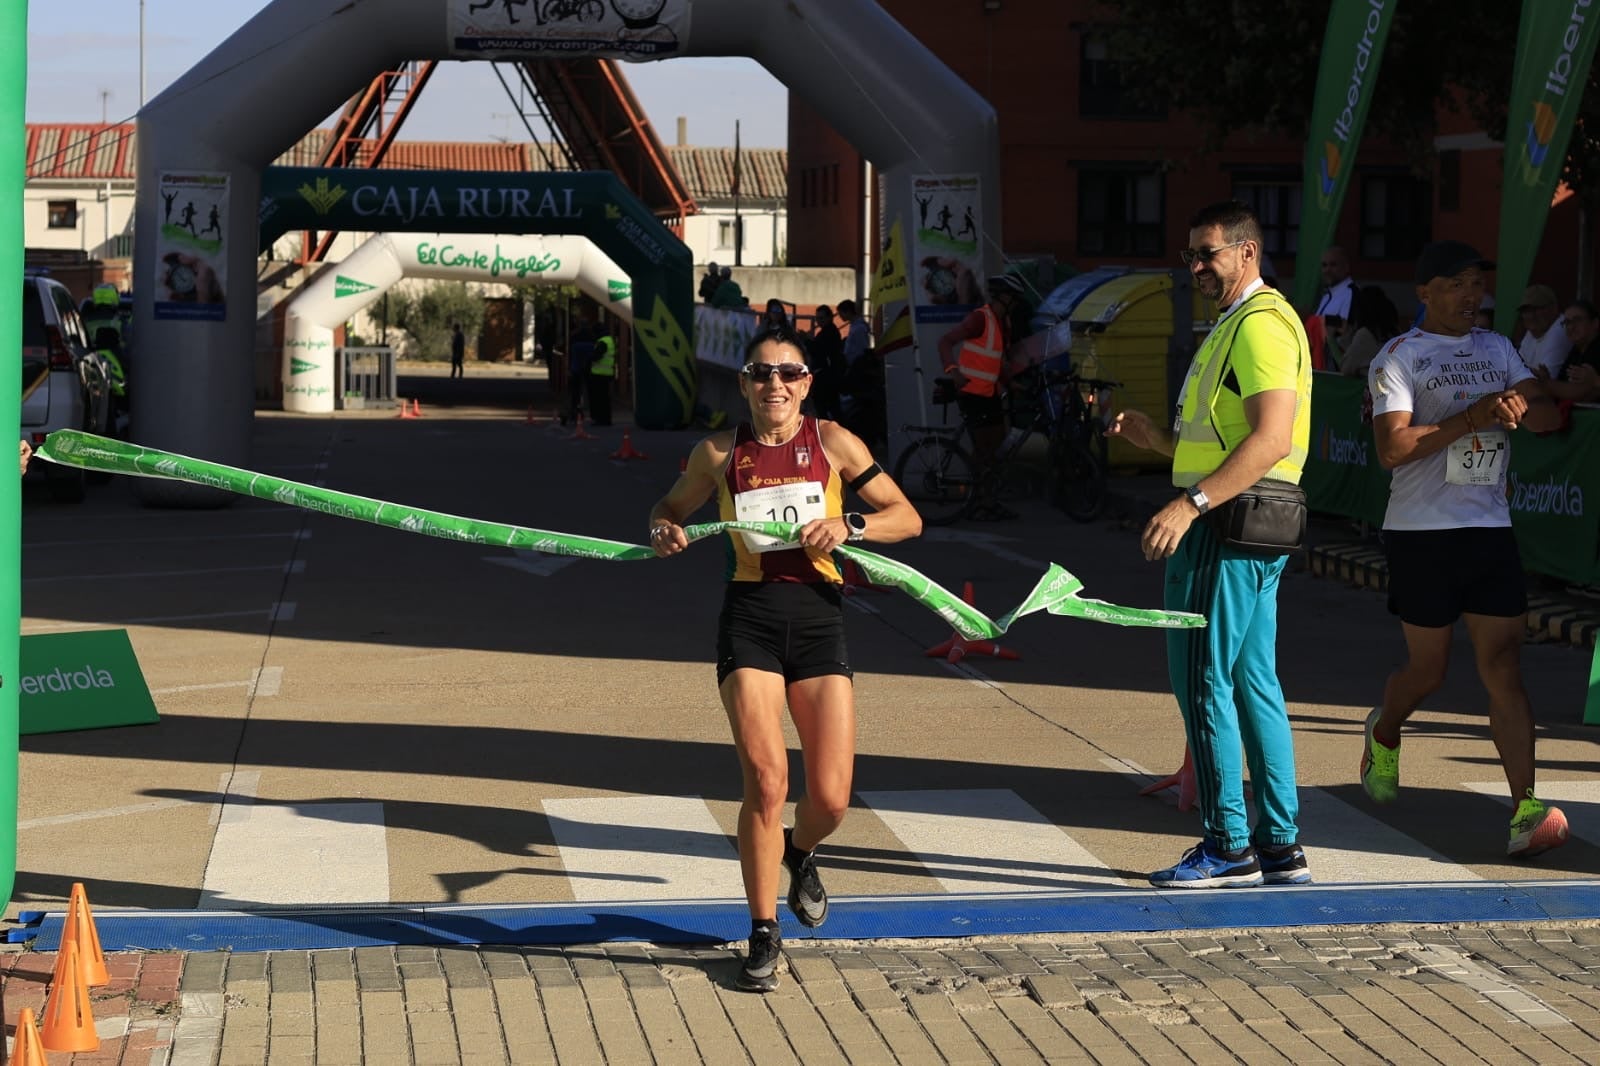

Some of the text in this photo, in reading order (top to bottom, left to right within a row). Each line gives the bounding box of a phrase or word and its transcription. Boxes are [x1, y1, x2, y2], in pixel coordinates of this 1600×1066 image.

[351, 185, 584, 224] CAJA RURAL
[416, 242, 561, 278] El Corte Inglés
[1440, 360, 1495, 373] III CARRERA
[1463, 449, 1497, 470] 377
[763, 477, 783, 486] CAJA
[1511, 471, 1584, 518] Iberdrola
[296, 492, 356, 518] Iberdrola
[766, 505, 799, 523] 10
[18, 664, 115, 695] erdrola
